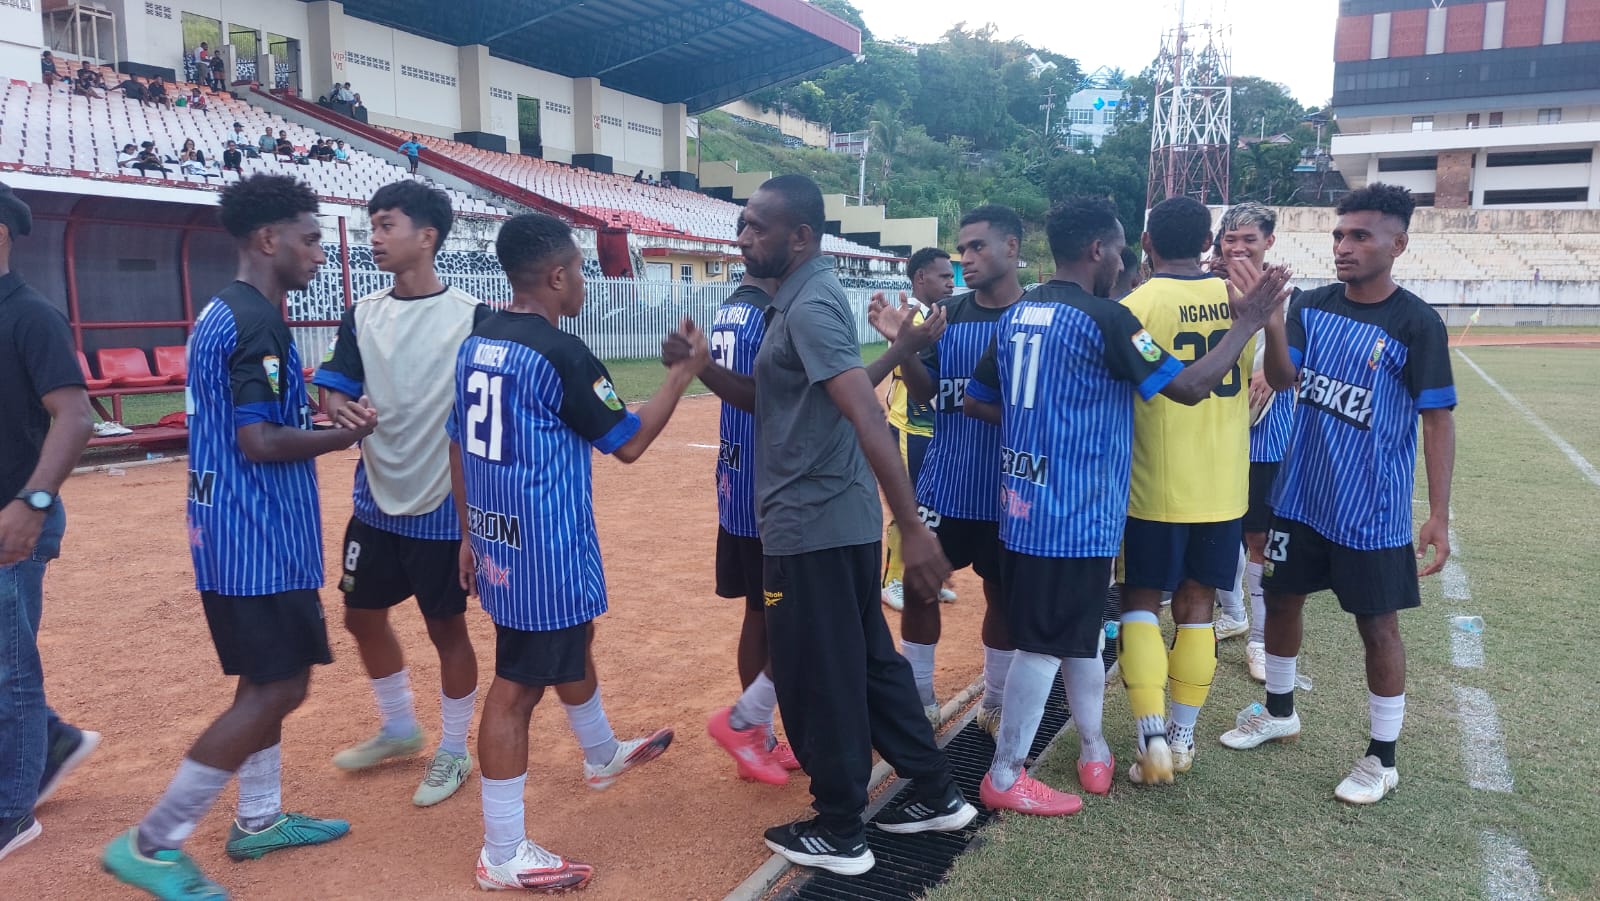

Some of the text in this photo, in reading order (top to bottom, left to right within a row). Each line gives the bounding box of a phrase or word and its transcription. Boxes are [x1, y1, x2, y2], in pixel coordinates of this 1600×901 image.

[1010, 332, 1042, 410] 11
[466, 371, 503, 461] 21
[345, 540, 361, 571] 8
